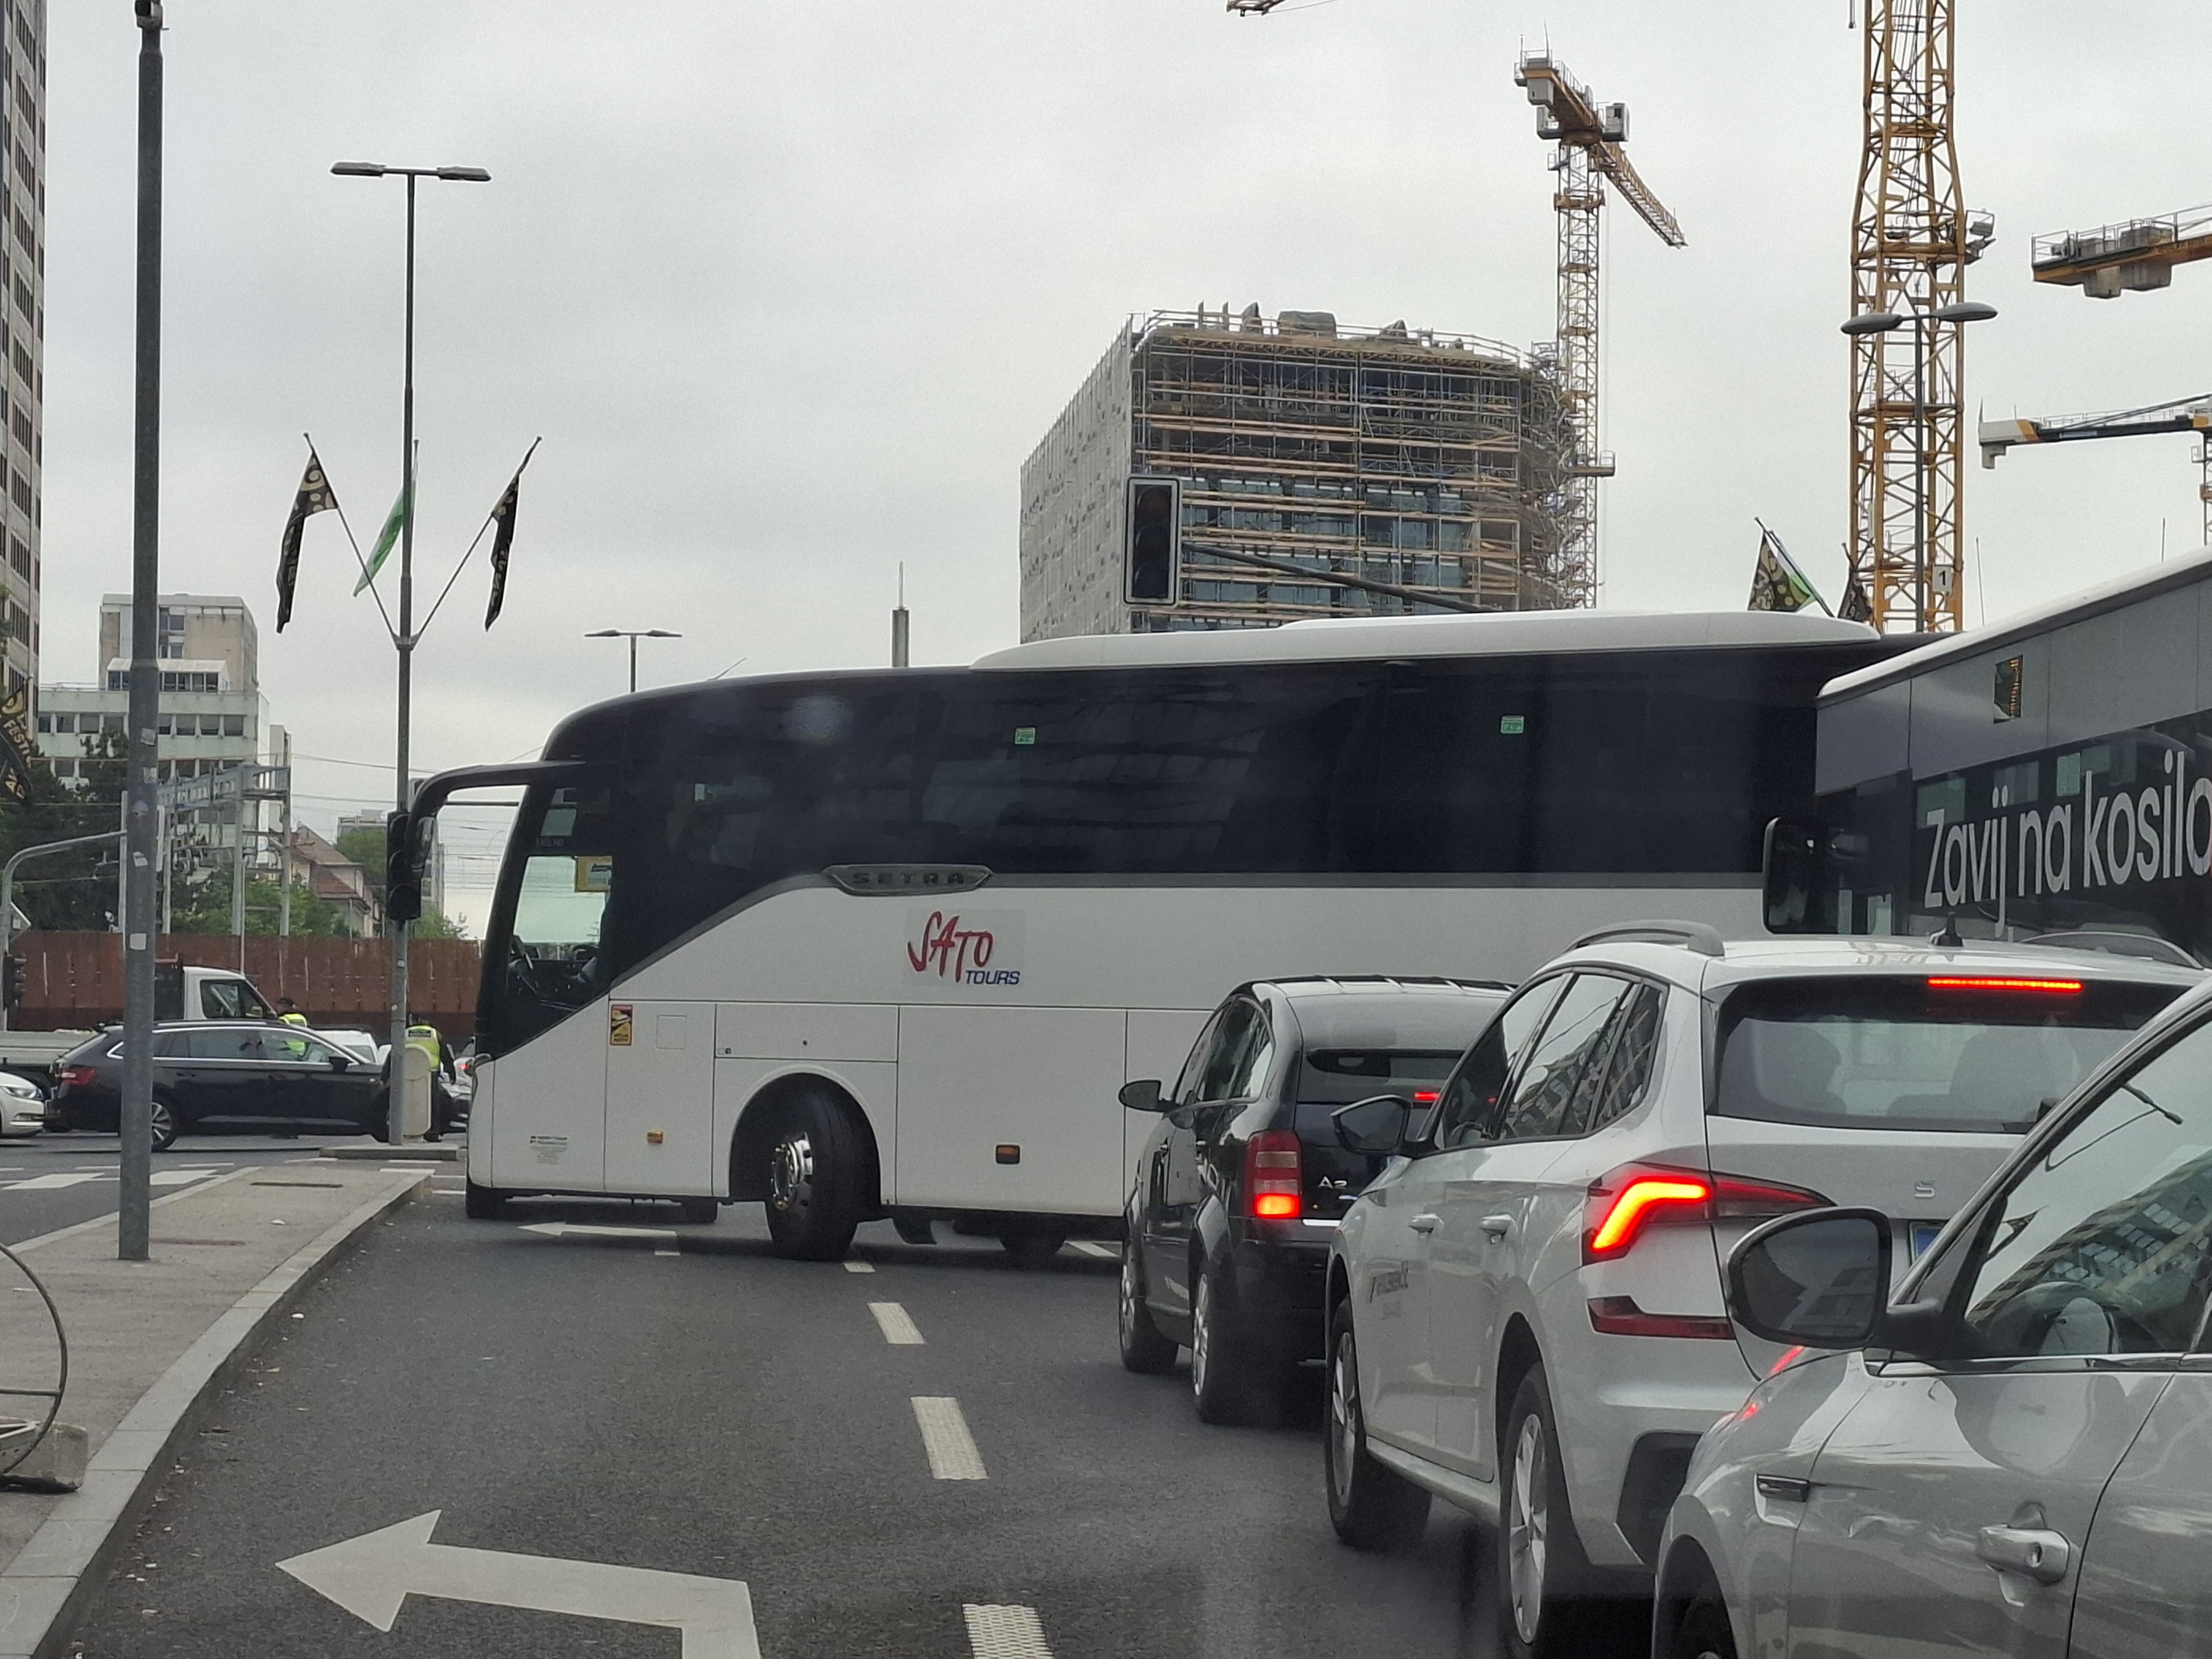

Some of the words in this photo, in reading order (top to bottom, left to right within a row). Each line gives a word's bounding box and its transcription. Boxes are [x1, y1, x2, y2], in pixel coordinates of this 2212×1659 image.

[1938, 570, 1946, 586] 1
[1924, 784, 2009, 938] Zavij
[2018, 803, 2072, 897] na
[2084, 748, 2212, 888] kosilo
[853, 872, 964, 885] SETRA
[908, 911, 994, 983] SATO
[966, 970, 1021, 985] TOURS
